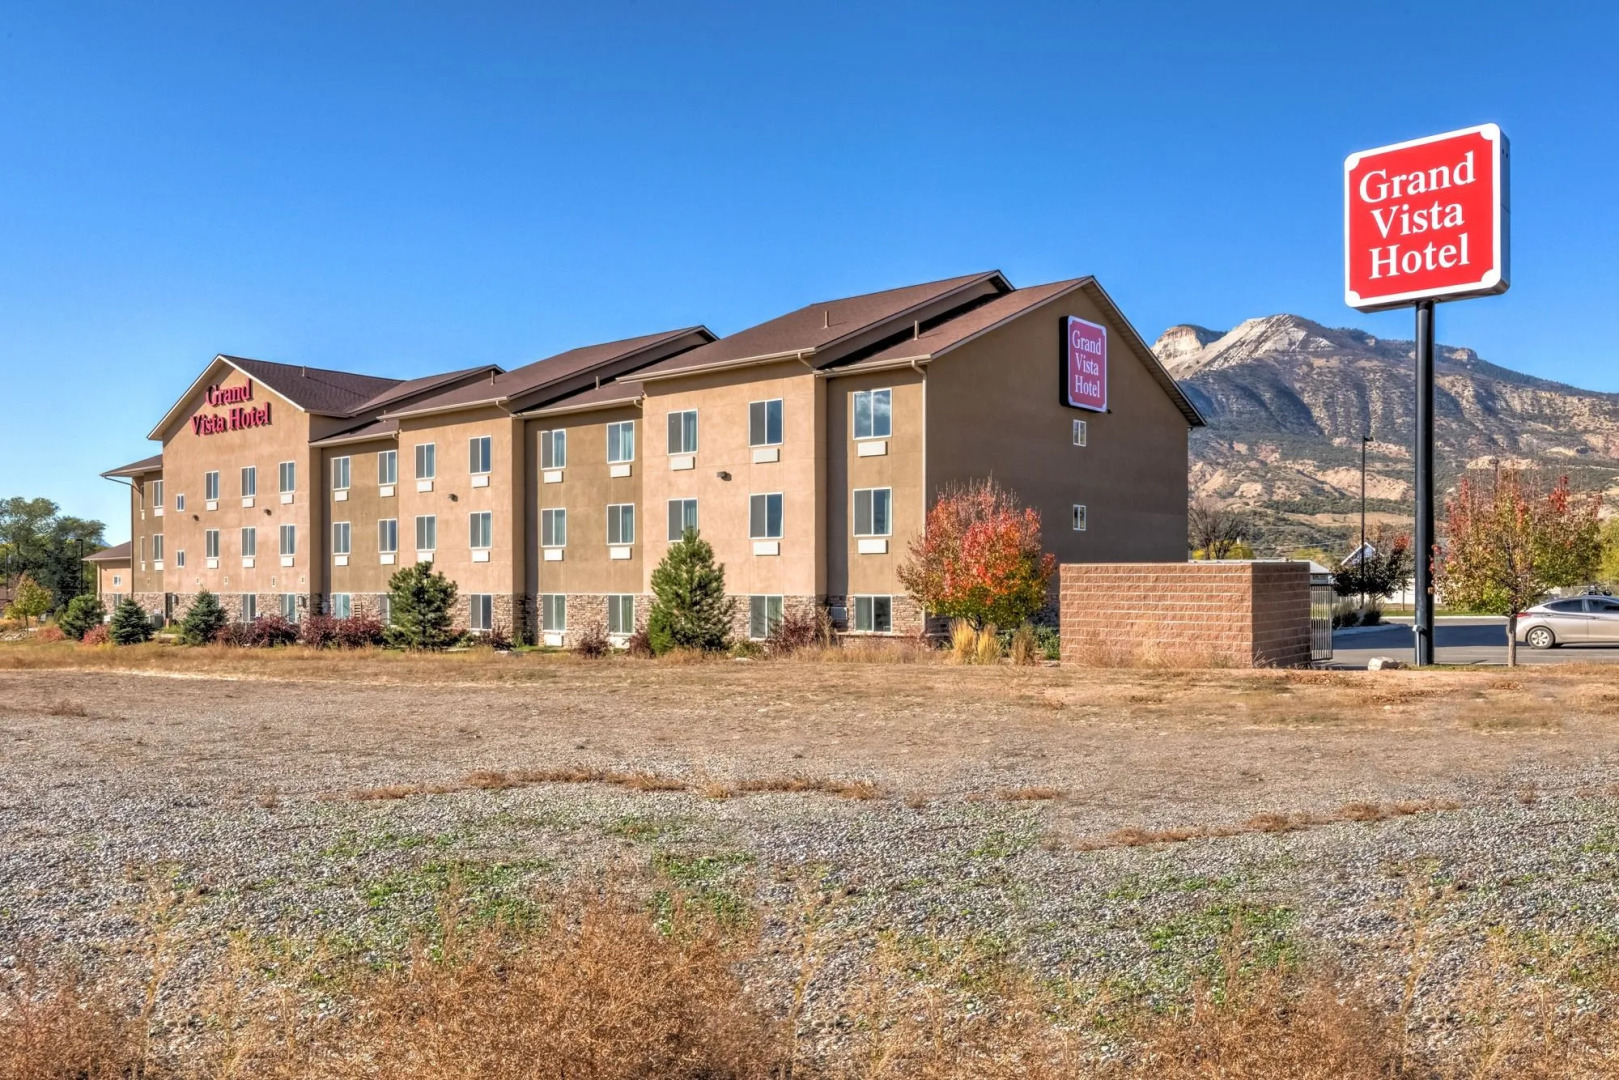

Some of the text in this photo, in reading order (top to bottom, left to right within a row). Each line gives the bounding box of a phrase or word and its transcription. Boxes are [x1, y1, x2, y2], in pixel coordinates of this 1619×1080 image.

[1359, 150, 1476, 203] Grand
[1370, 200, 1465, 239] Vista
[1368, 232, 1471, 280] Hotel
[1072, 330, 1102, 355] Grand
[1075, 352, 1099, 376] Vista
[206, 378, 252, 407] Grand
[1074, 374, 1101, 398] Hotel
[190, 401, 271, 435] Vista Hotel
